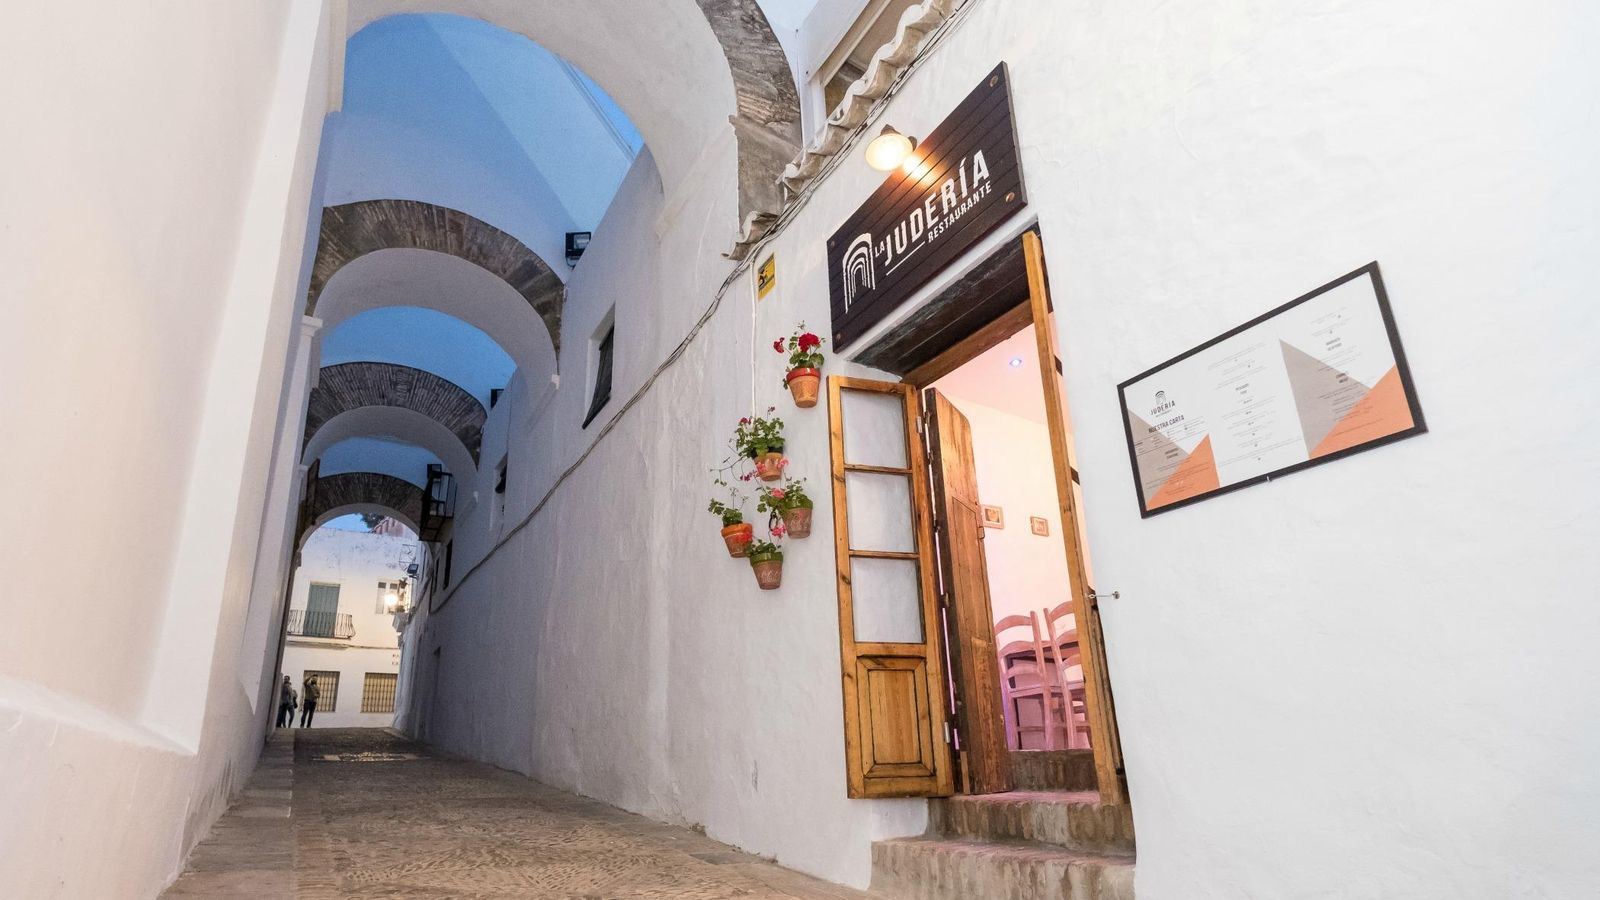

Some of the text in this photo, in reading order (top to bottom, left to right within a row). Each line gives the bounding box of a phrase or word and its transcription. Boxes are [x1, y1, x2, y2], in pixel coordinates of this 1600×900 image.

[874, 149, 990, 266] LA JUDERÍA
[928, 180, 992, 244] RESTAURANTE
[1169, 414, 1185, 426] CARTA
